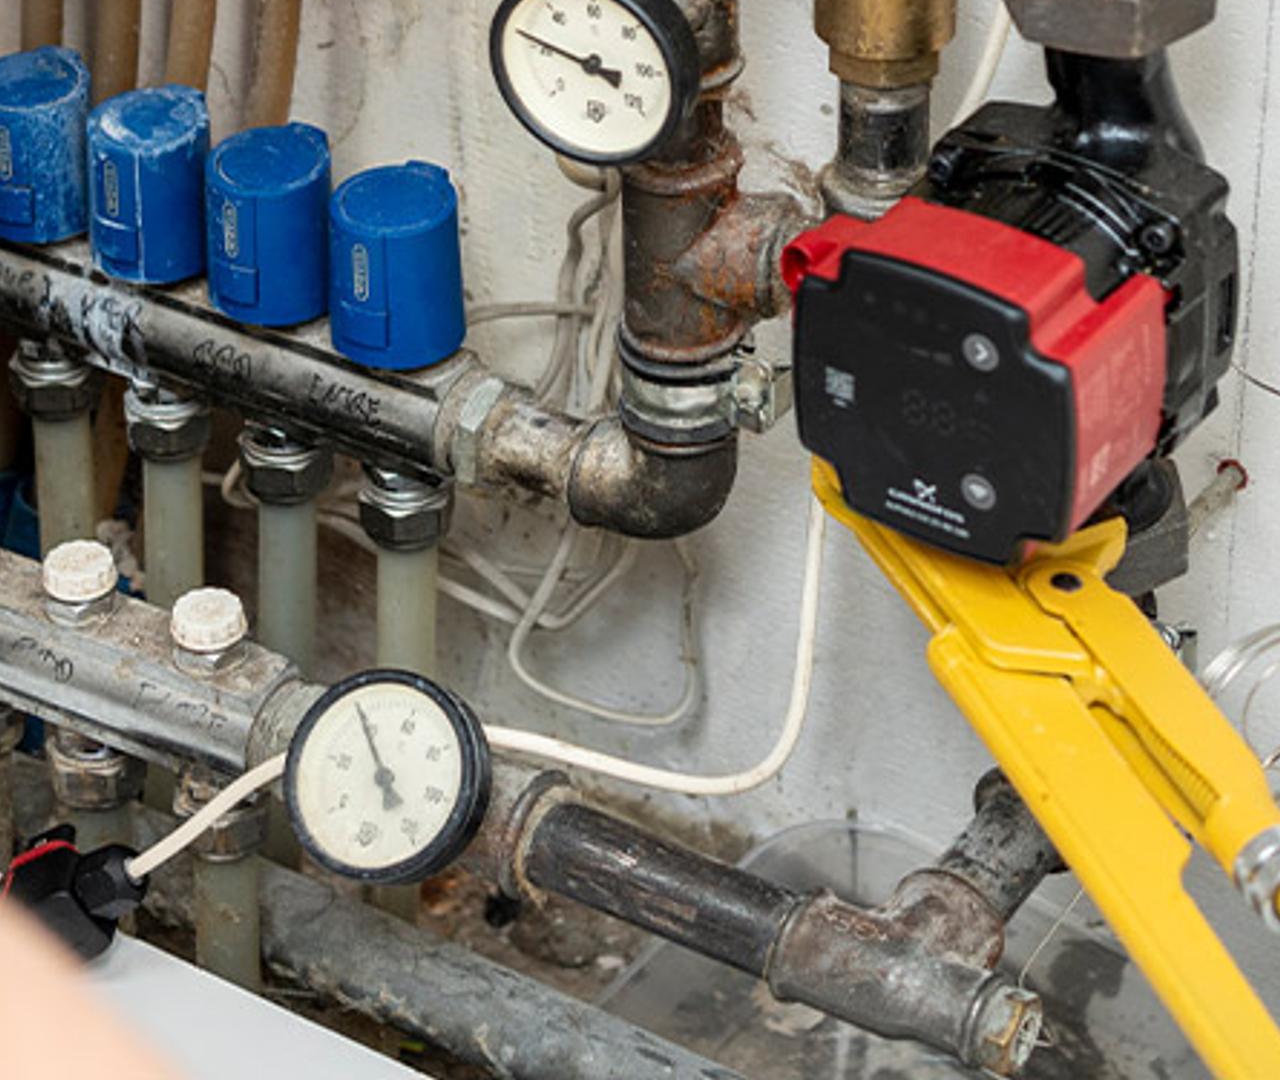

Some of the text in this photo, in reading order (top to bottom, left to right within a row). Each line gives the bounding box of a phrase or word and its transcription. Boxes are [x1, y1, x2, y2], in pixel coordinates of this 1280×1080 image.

[586, 4, 602, 20] 60
[621, 25, 637, 41] 80
[635, 62, 654, 79] 100
